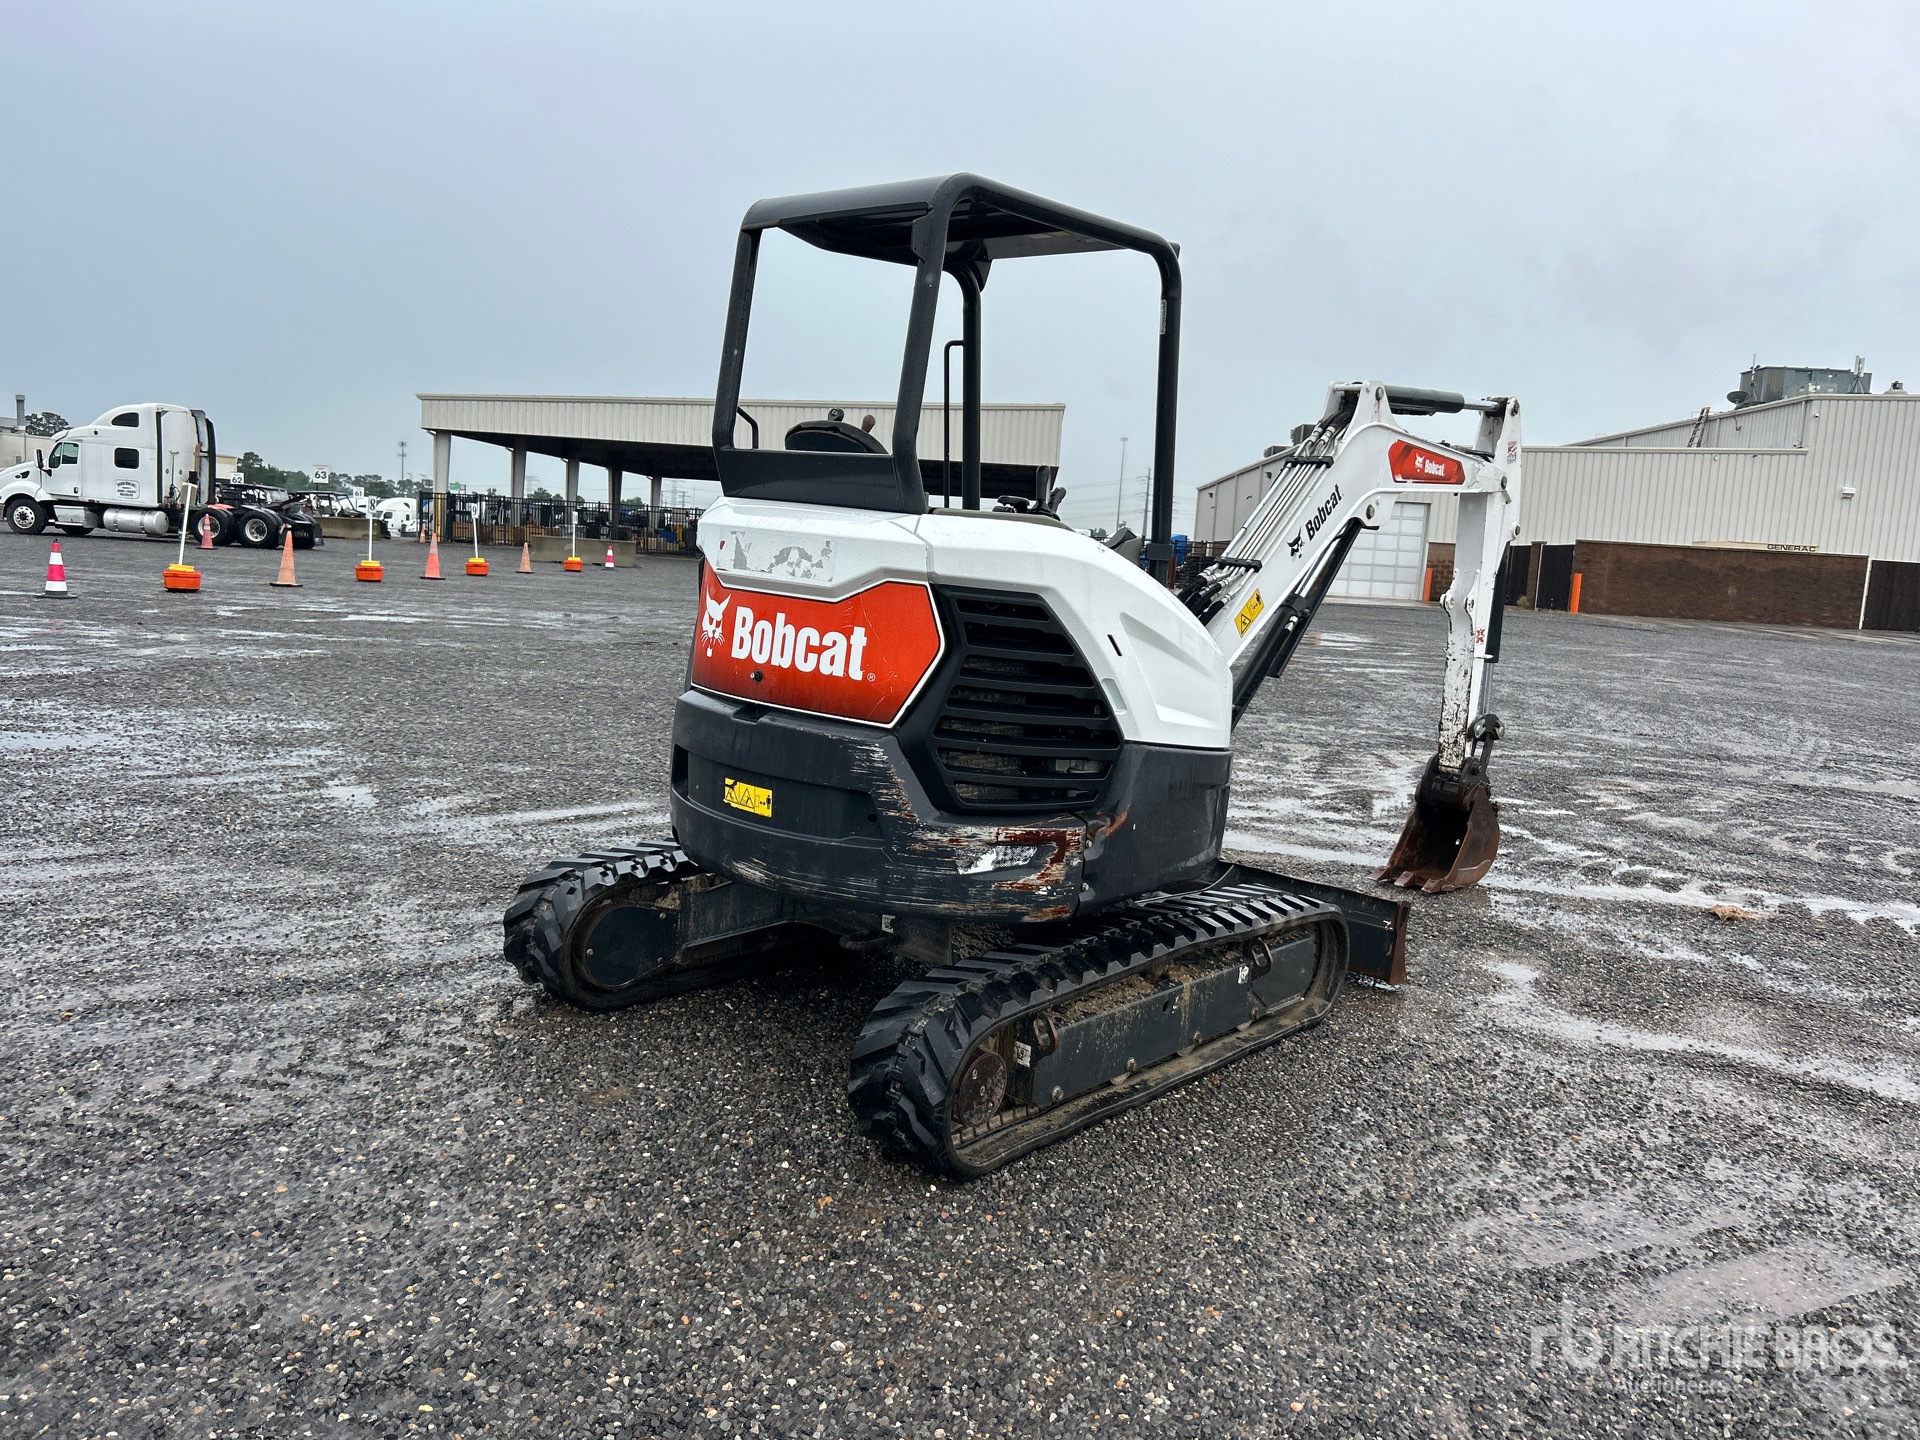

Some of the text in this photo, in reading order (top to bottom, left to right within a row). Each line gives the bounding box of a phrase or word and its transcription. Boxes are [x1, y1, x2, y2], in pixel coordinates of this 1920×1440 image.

[1424, 459, 1445, 476] Bobcat
[232, 476, 243, 484] 62
[315, 470, 326, 479] 63
[370, 498, 375, 511] 8
[473, 505, 477, 516] 9
[1305, 483, 1342, 541] Bobcat
[1767, 543, 1816, 552] GENERAC
[731, 605, 867, 681] Bobcat
